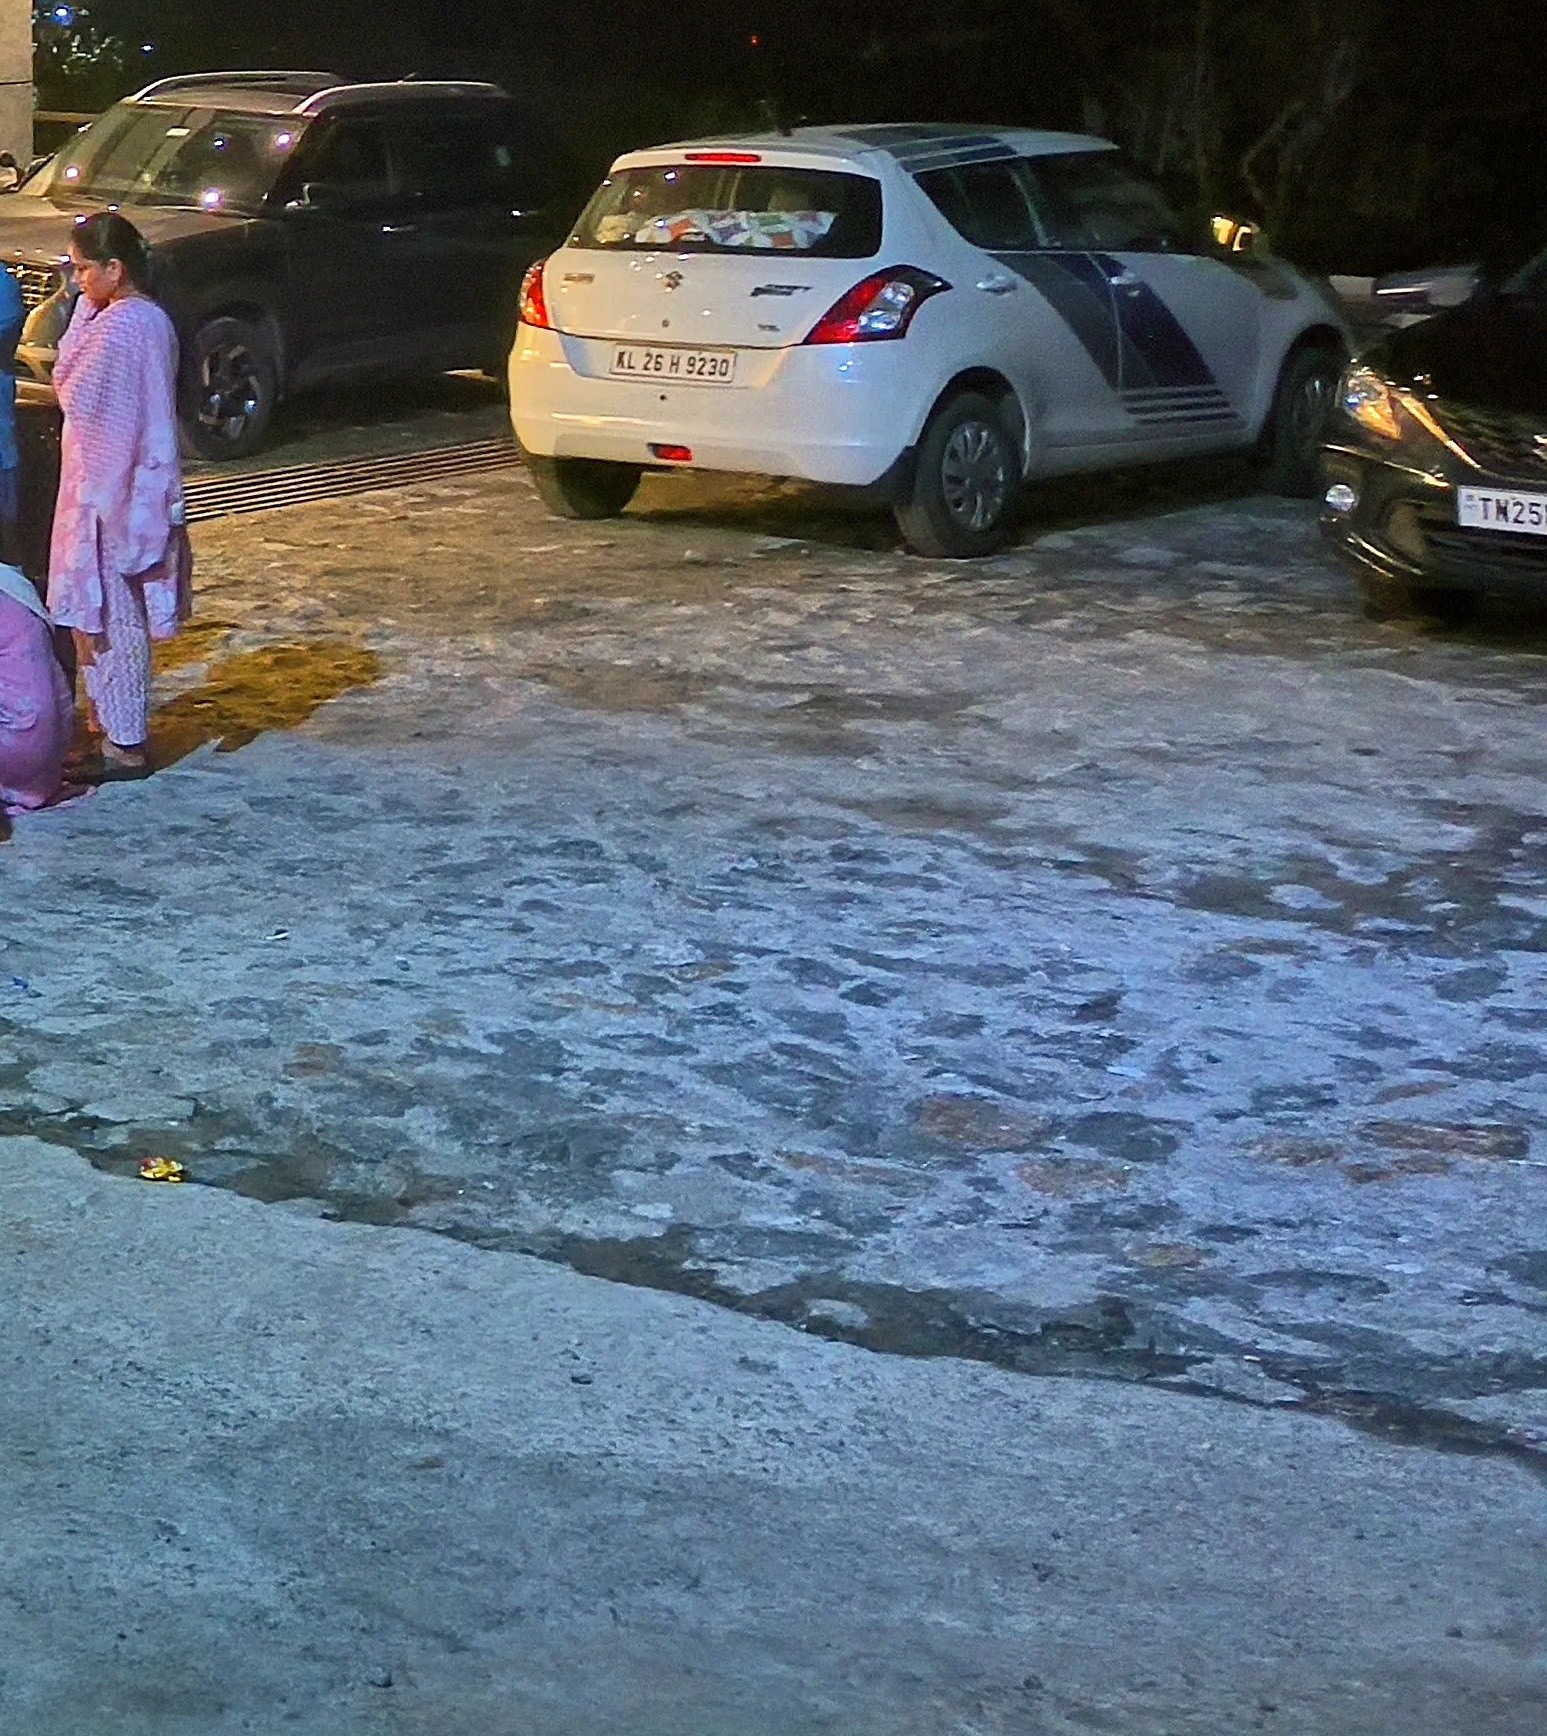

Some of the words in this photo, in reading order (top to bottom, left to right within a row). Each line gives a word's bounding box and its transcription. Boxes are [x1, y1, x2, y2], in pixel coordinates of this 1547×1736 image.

[616, 351, 636, 370] KL
[642, 352, 664, 372] 26
[668, 355, 681, 374] H
[685, 356, 730, 377] 9230
[1478, 497, 1547, 526] TN25
